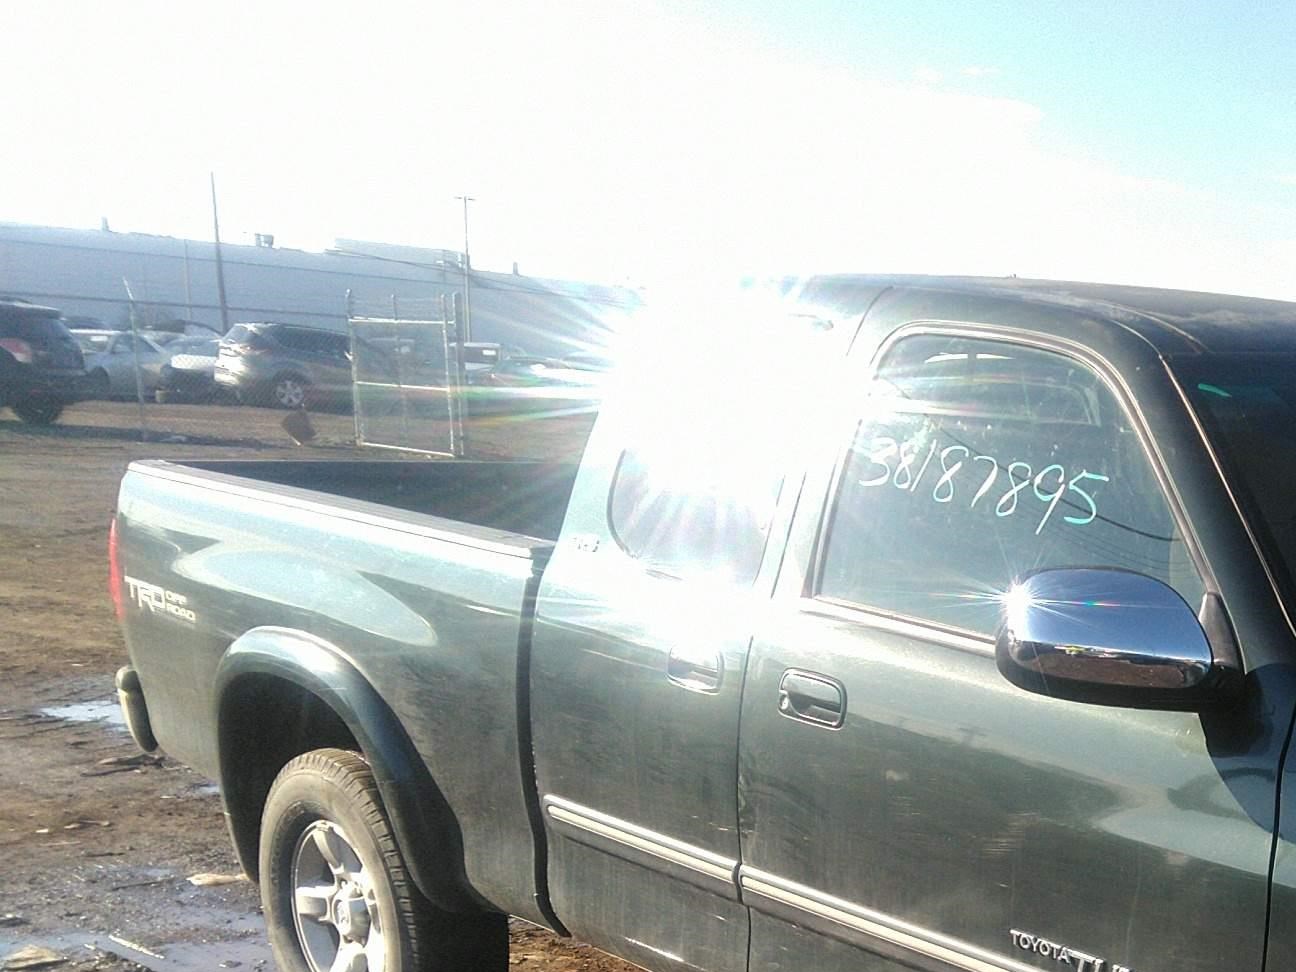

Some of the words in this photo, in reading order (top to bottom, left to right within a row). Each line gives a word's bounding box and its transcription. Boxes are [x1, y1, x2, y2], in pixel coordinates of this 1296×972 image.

[858, 436, 1110, 536] 38187895
[124, 575, 166, 613] TRD
[165, 602, 197, 624] ROAD
[1009, 928, 1071, 964] TOYOTA
